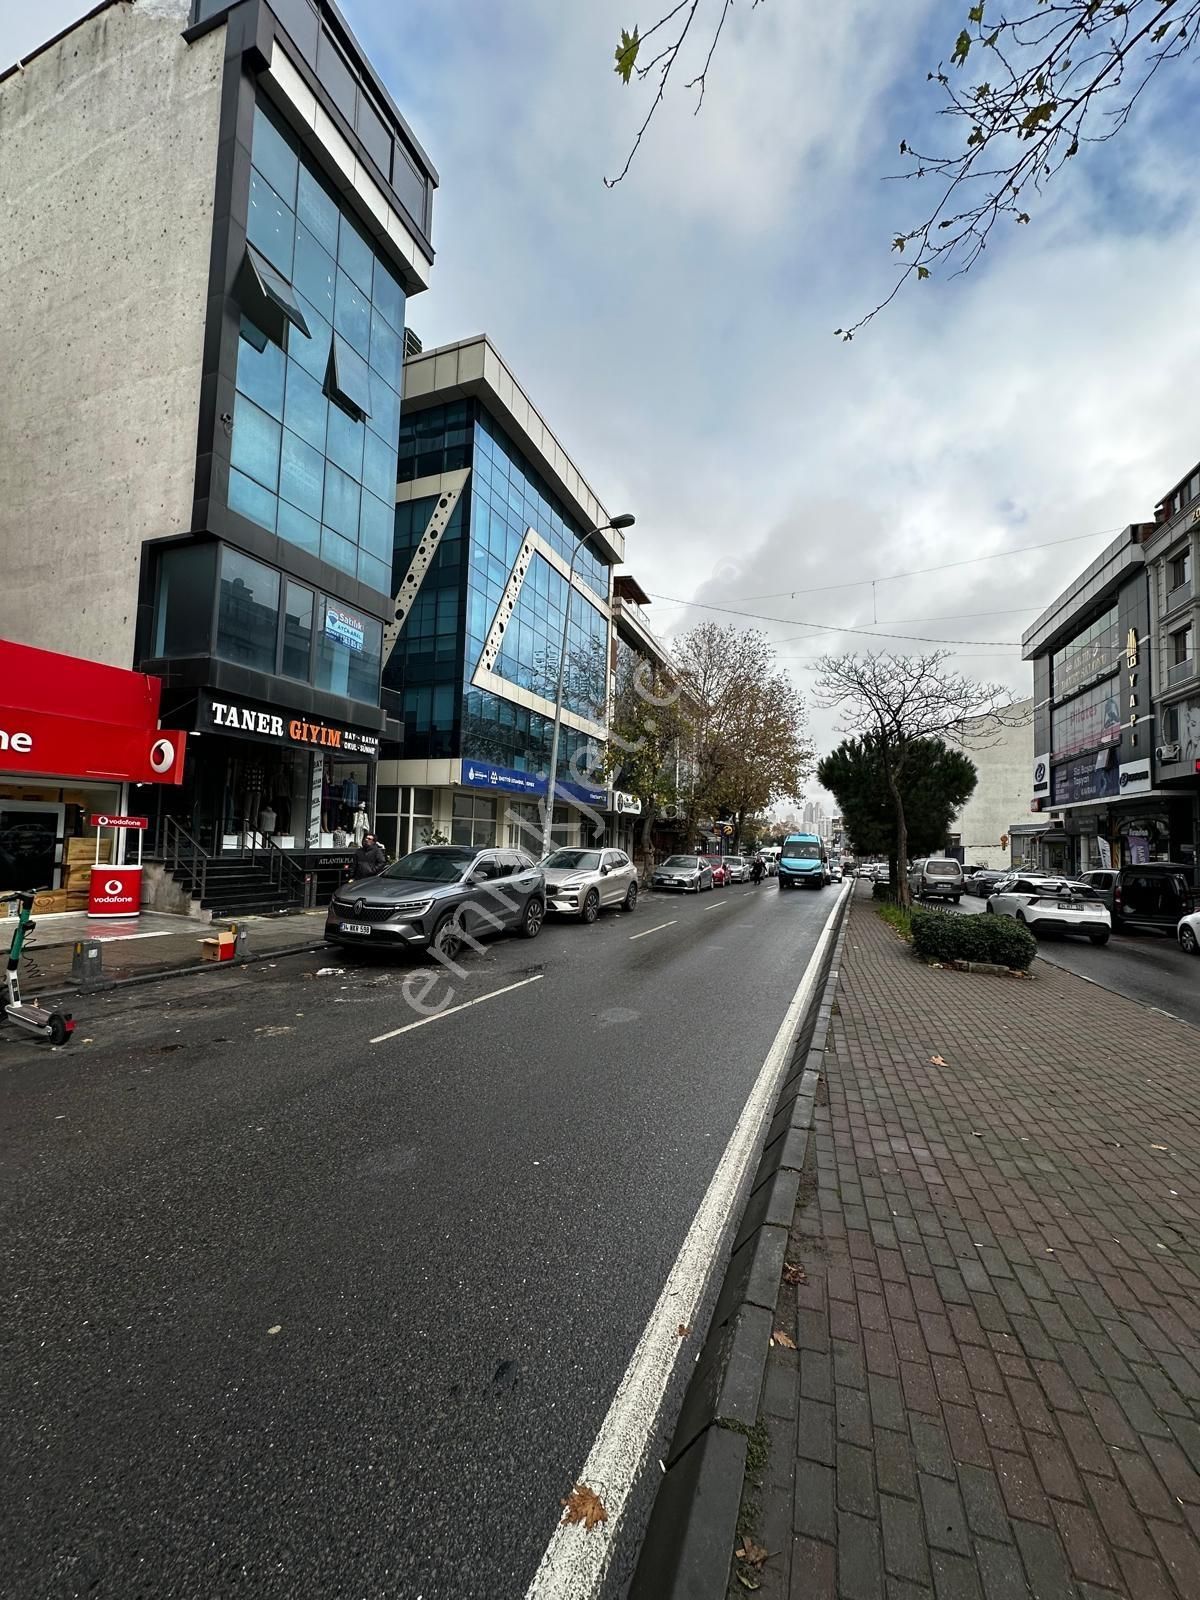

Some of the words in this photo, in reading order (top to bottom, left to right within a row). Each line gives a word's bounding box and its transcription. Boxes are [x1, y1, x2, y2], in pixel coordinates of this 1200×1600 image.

[212, 702, 284, 737] TANER
[288, 717, 342, 748] GİYİM
[109, 818, 141, 826] vodafone
[345, 857, 355, 865] PLA
[93, 895, 133, 904] vodafone
